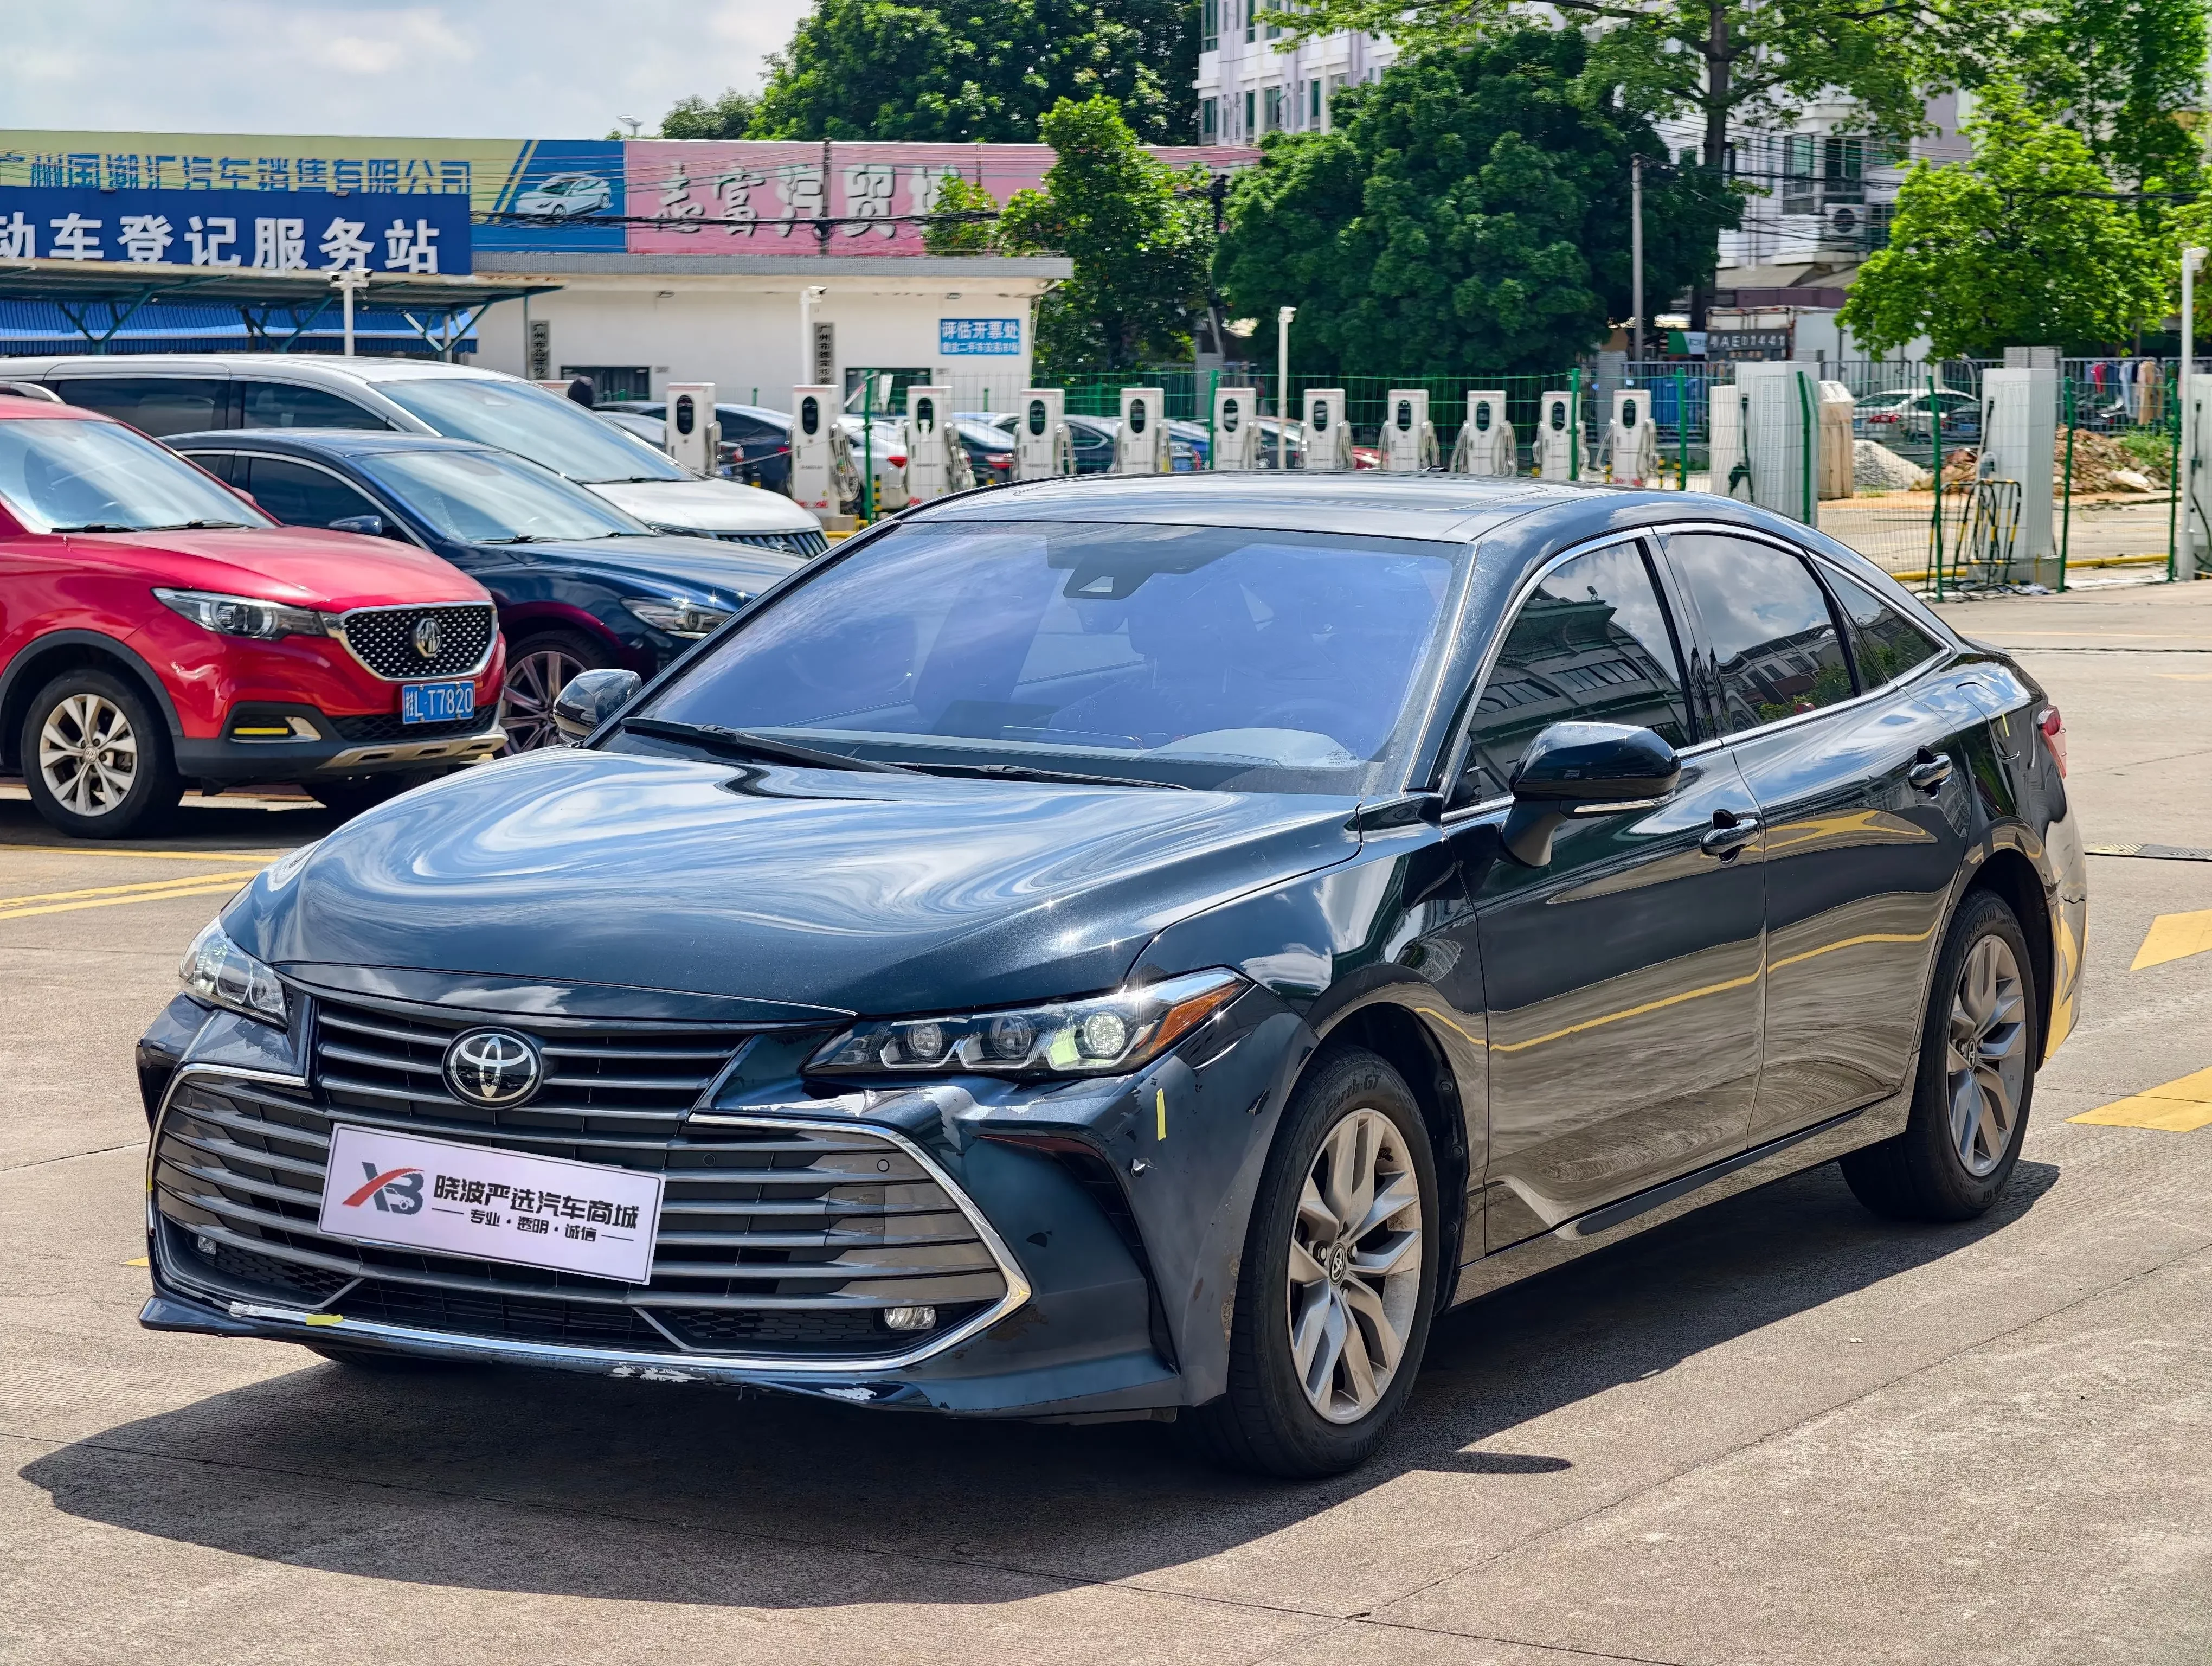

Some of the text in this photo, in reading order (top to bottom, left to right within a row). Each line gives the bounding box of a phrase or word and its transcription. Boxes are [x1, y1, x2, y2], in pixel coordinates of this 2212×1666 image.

[0, 211, 440, 274] 动车登记服务站
